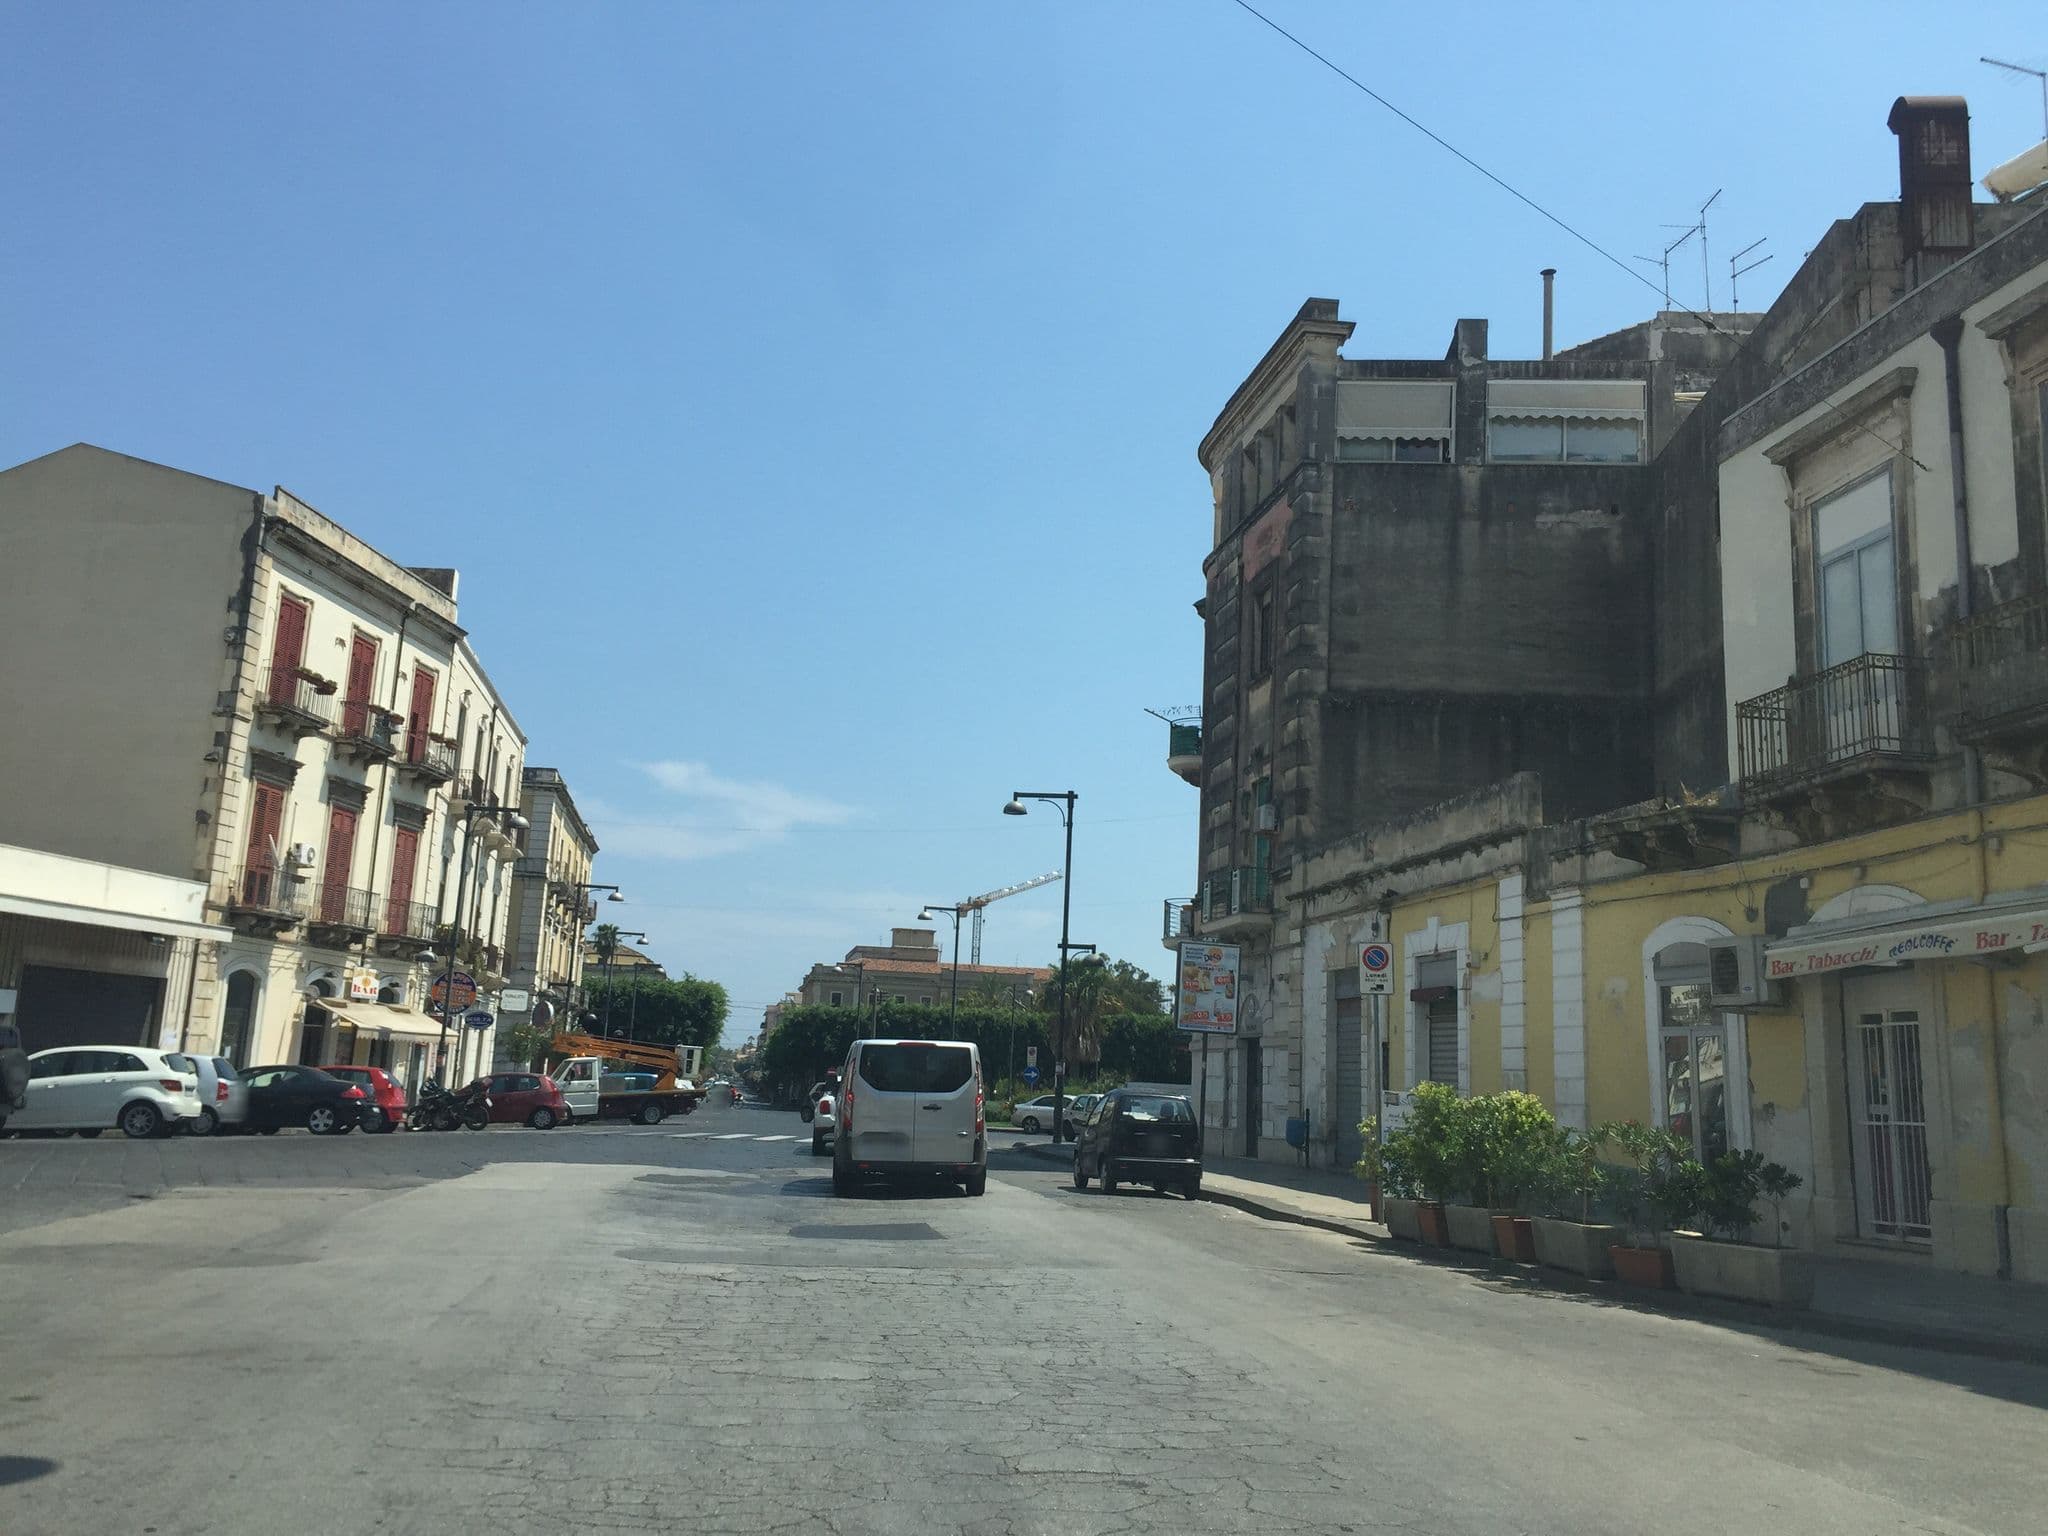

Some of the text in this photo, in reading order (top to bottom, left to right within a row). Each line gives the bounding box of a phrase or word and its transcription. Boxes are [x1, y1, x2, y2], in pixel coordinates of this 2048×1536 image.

[1976, 931, 2010, 950] Bar
[1771, 959, 1796, 976] Bar
[1807, 945, 1879, 971] Tabacchi
[352, 984, 378, 995] BAR
